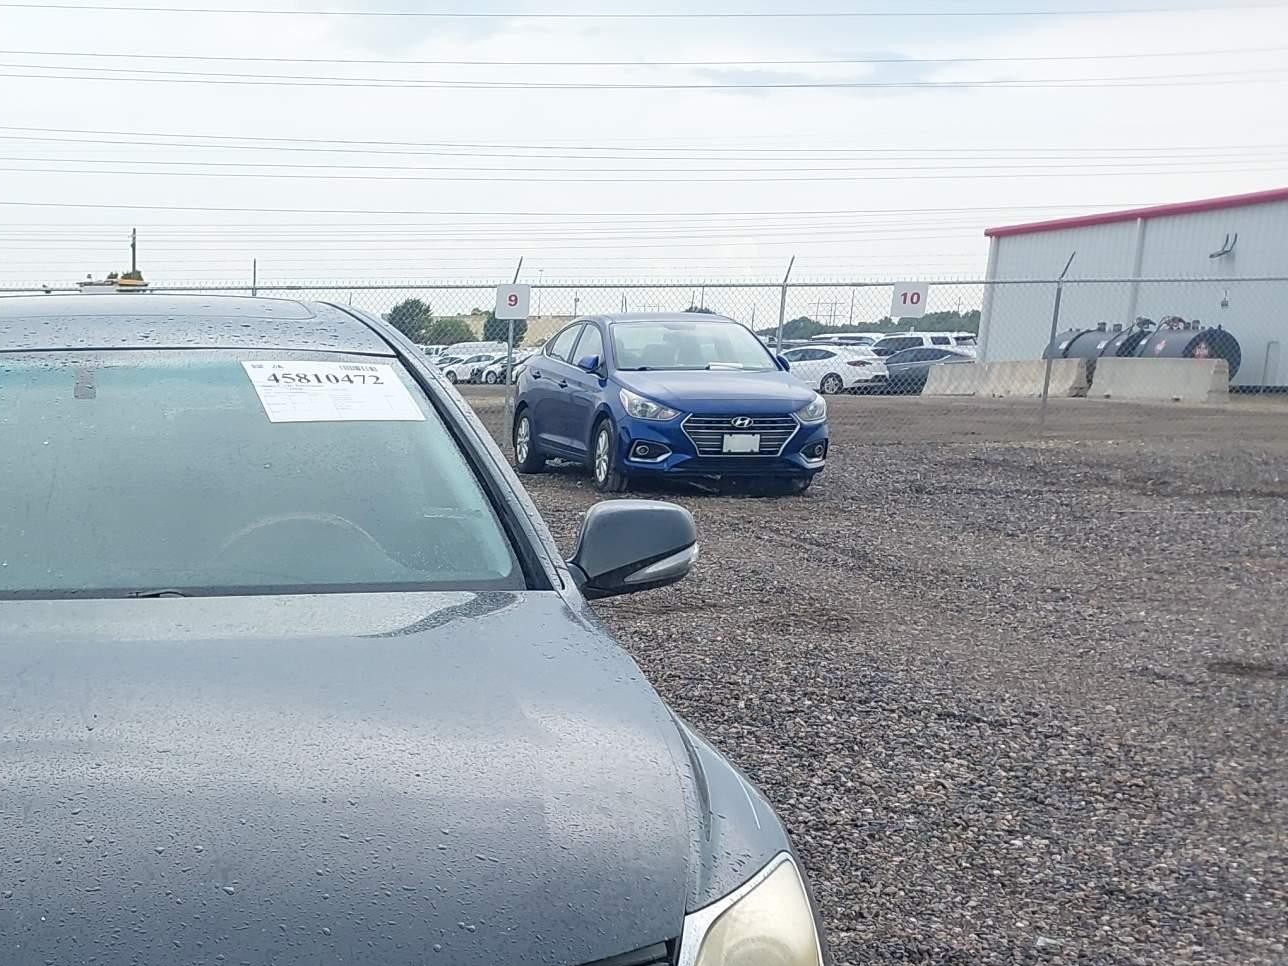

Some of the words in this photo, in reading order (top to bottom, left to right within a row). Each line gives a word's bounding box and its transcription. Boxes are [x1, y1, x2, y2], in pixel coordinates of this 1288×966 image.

[508, 294, 518, 306] 9
[901, 292, 920, 304] 10
[267, 373, 384, 385] 45810472
